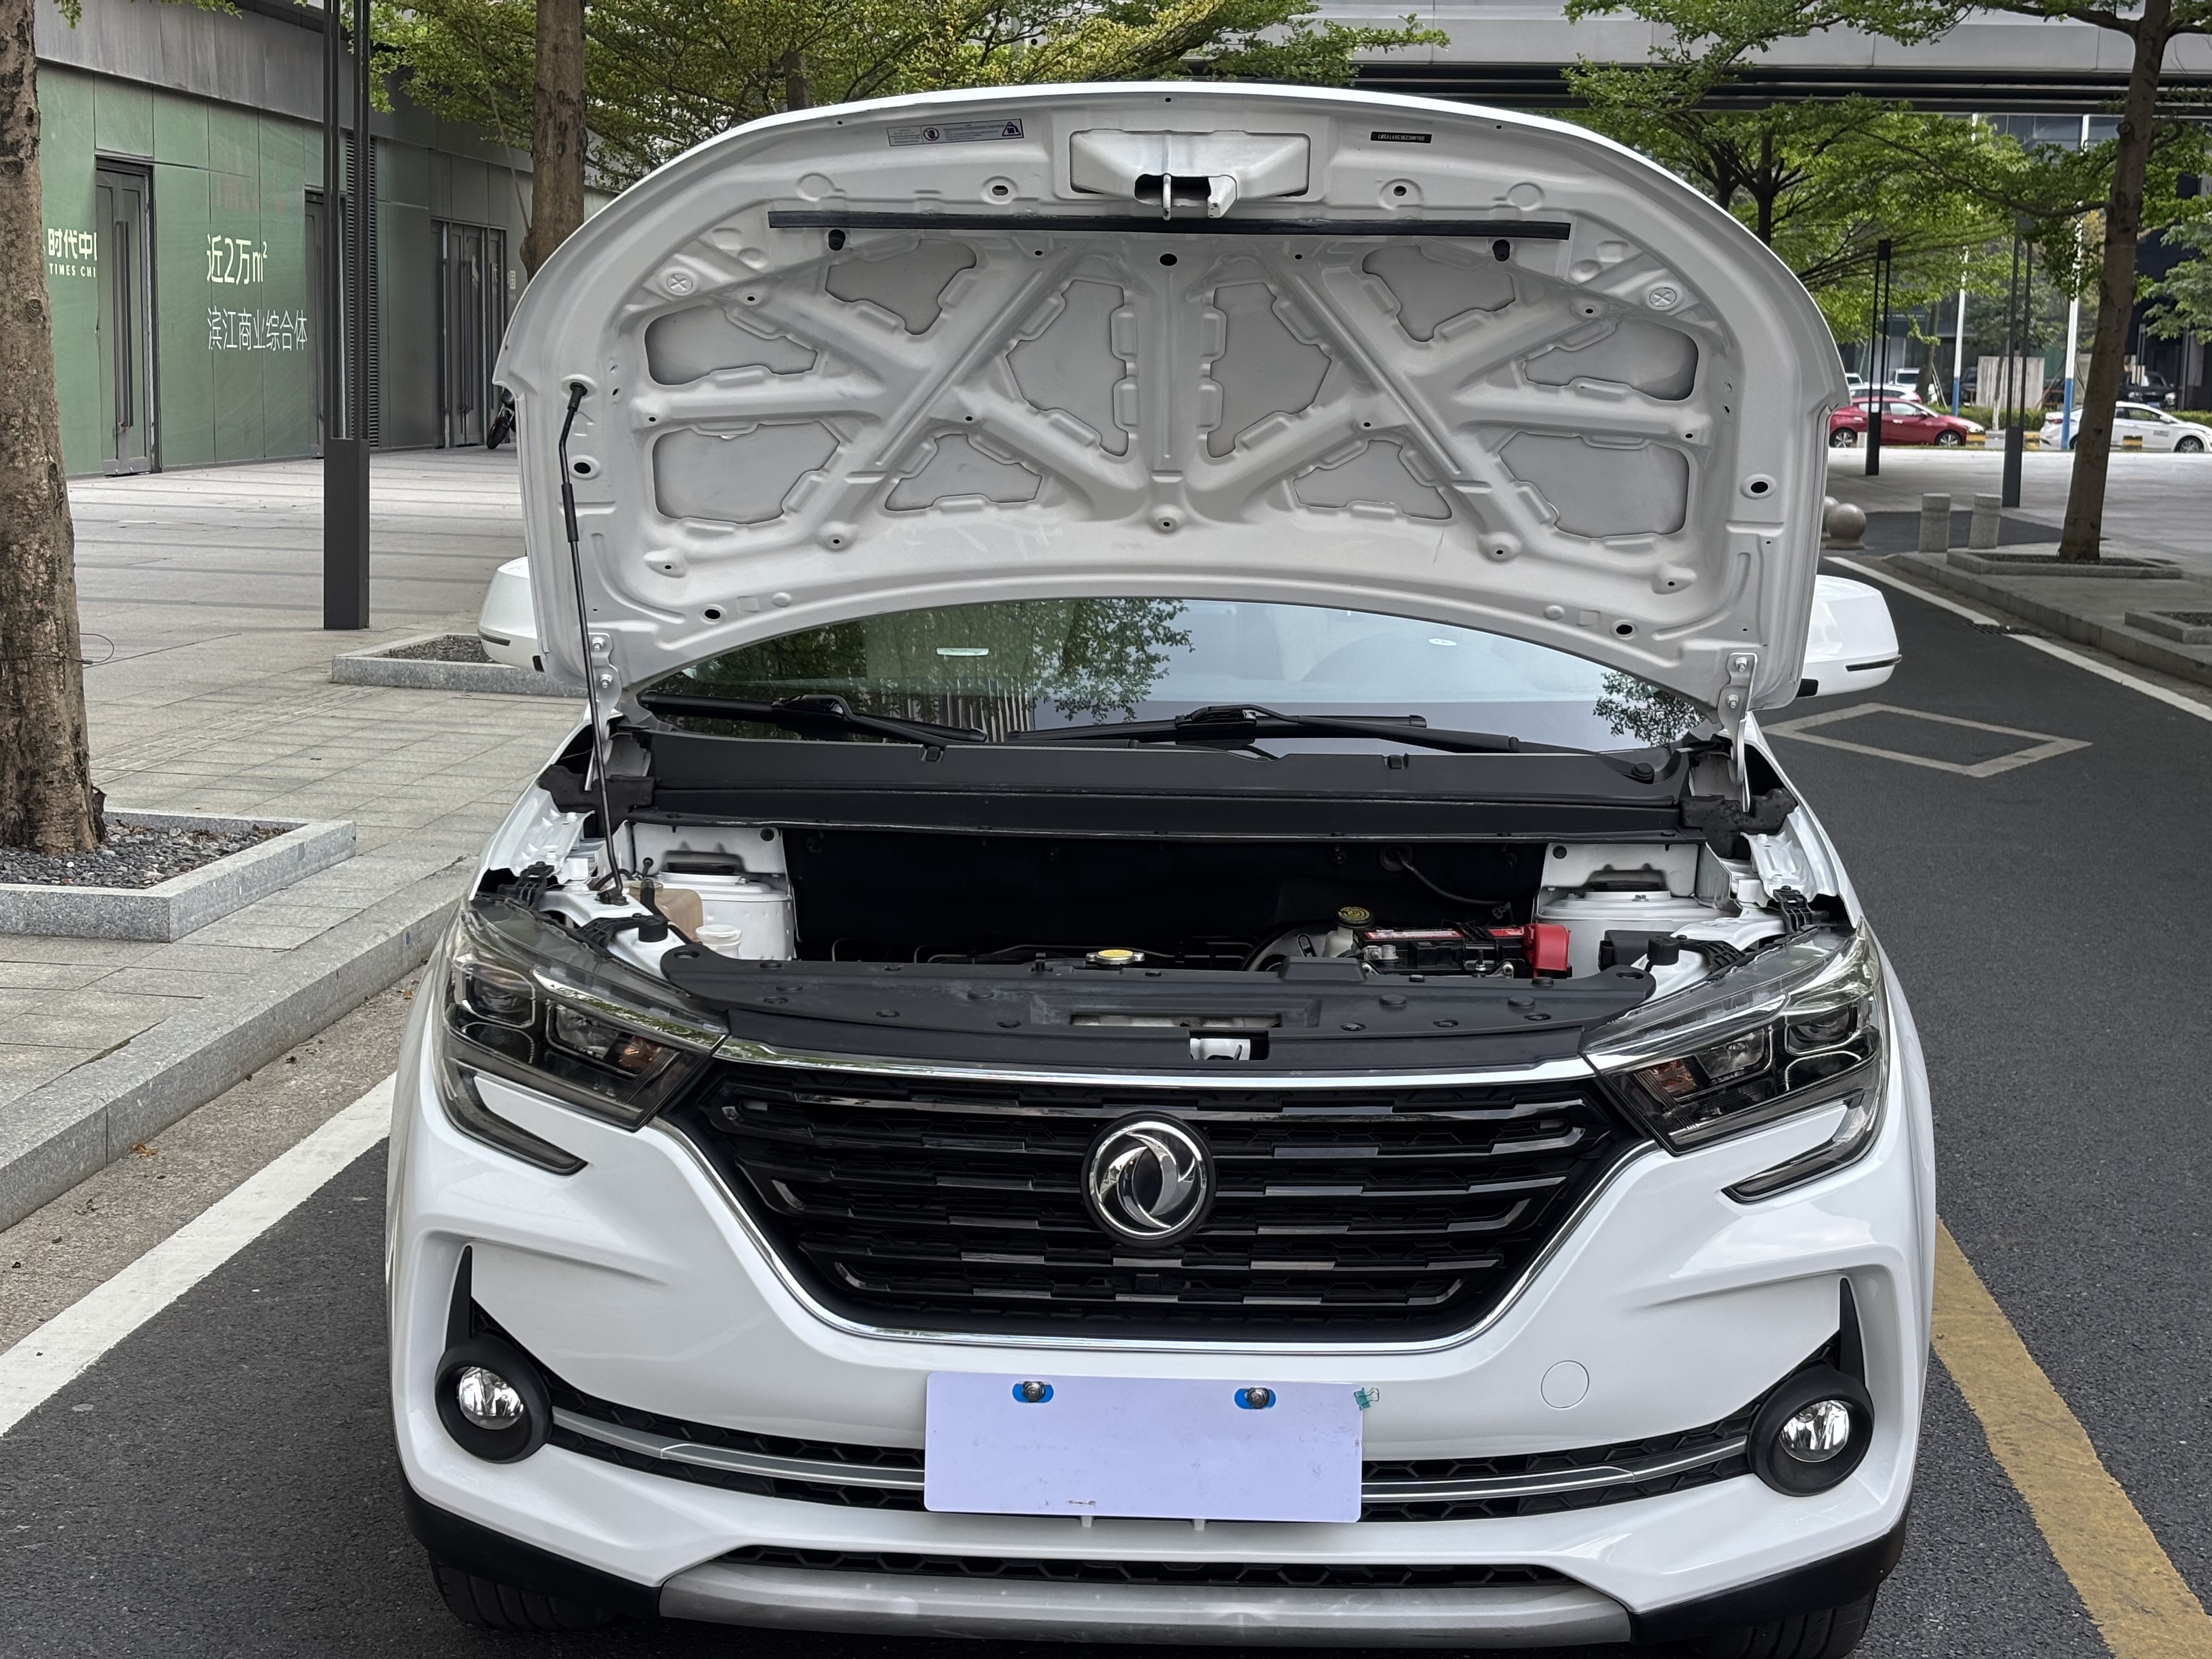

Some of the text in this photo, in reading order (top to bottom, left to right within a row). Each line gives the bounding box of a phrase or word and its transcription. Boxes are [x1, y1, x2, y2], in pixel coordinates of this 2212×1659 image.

[48, 228, 98, 261] 时代中
[49, 263, 76, 276] TIMES
[207, 305, 308, 351] 滨江商业综合体
